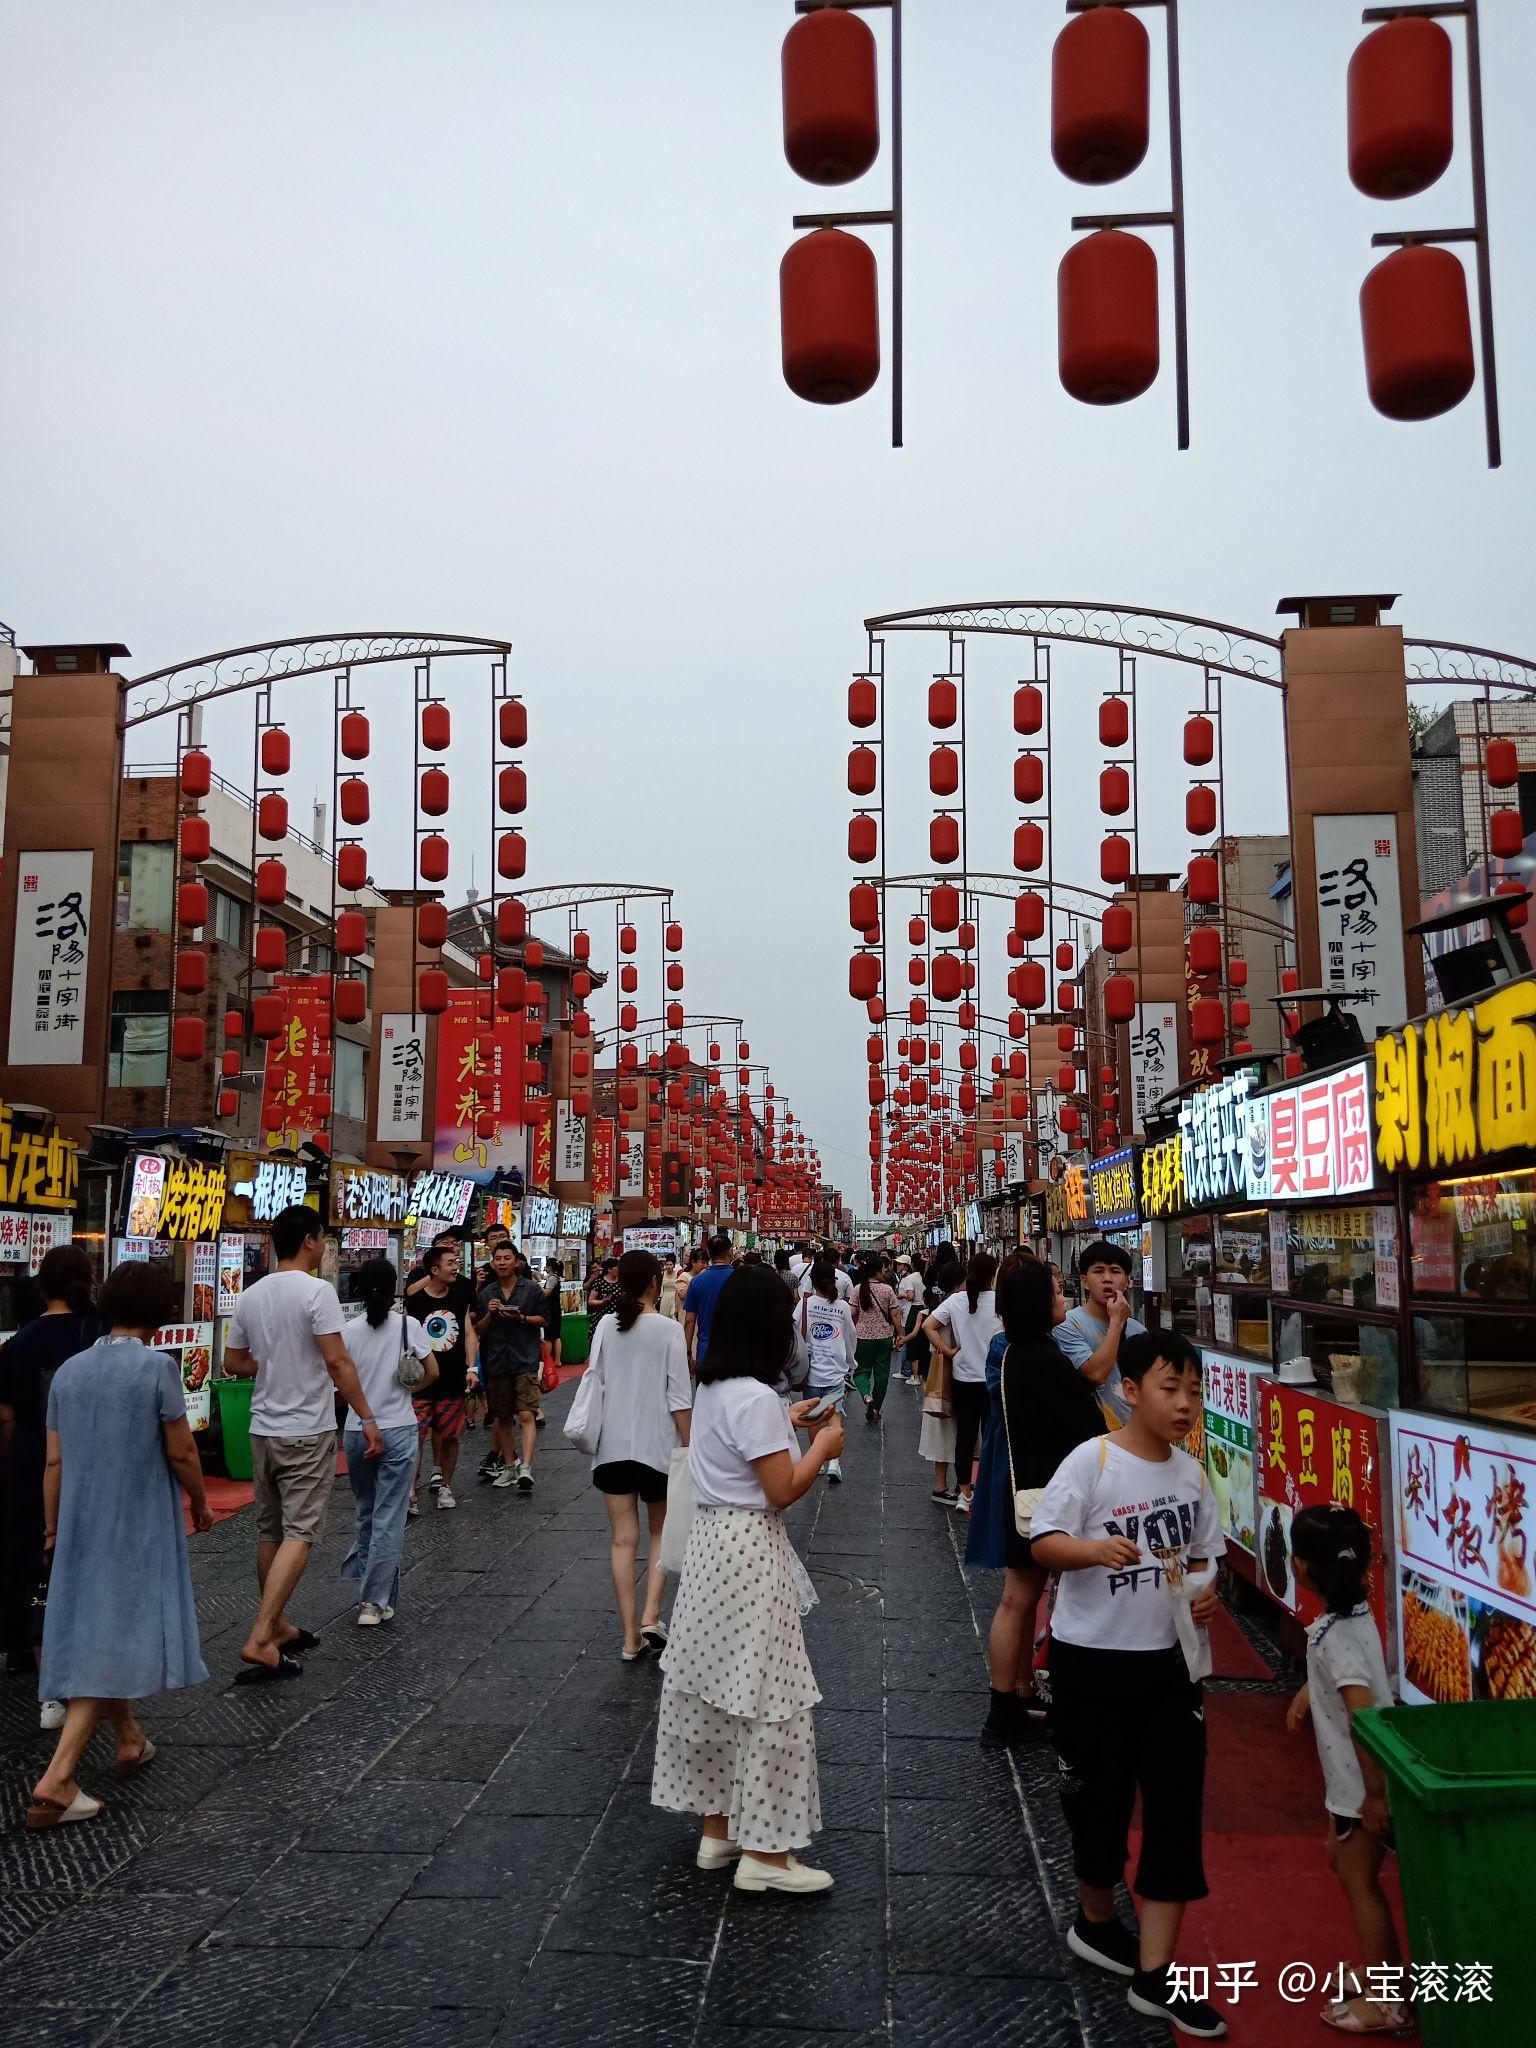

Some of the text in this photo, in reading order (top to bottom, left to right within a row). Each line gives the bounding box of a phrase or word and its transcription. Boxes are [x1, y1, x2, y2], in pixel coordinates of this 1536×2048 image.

[36, 892, 87, 1031] 洛陽十字街
[1319, 859, 1380, 1007] 洛陽十字街
[393, 1039, 423, 1122] 洛陽十字街
[1271, 1073, 1368, 1193] 臭豆腐
[158, 1159, 226, 1240] 烤猪蹄
[234, 1161, 306, 1220] 一根排骨
[3, 1248, 21, 1260] 炒面
[1269, 1393, 1354, 1510] 臭豆腐
[1112, 1506, 1136, 1518] GRASP
[1138, 1503, 1150, 1512] ALL
[1151, 1497, 1167, 1508] LOSE
[1404, 1440, 1536, 1579] 剁椒烤
